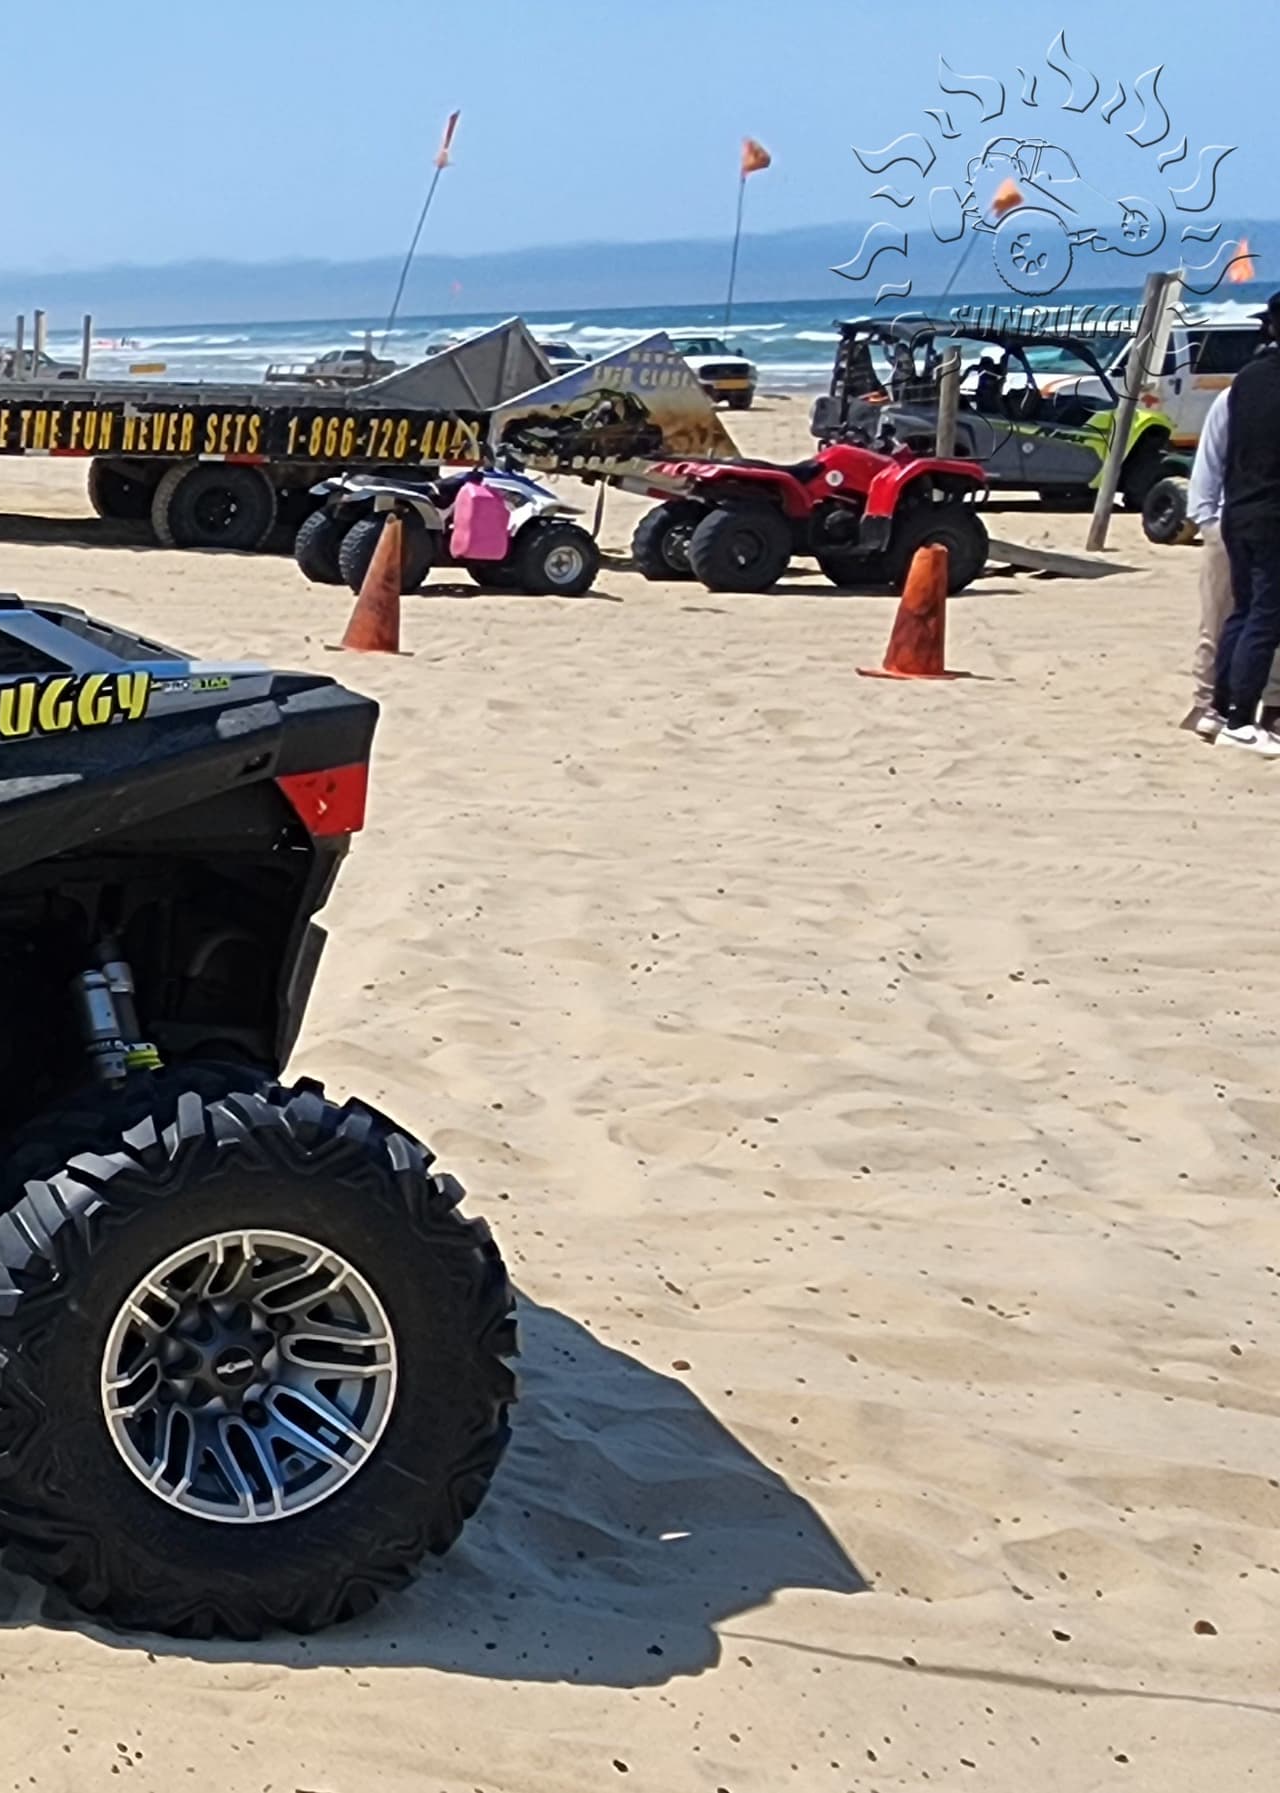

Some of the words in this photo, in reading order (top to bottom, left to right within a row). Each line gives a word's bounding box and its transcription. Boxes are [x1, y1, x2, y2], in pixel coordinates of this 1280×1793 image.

[20, 409, 62, 449] THE
[70, 410, 114, 450] FUN
[121, 412, 195, 450] NEVER
[203, 413, 261, 453] SETS
